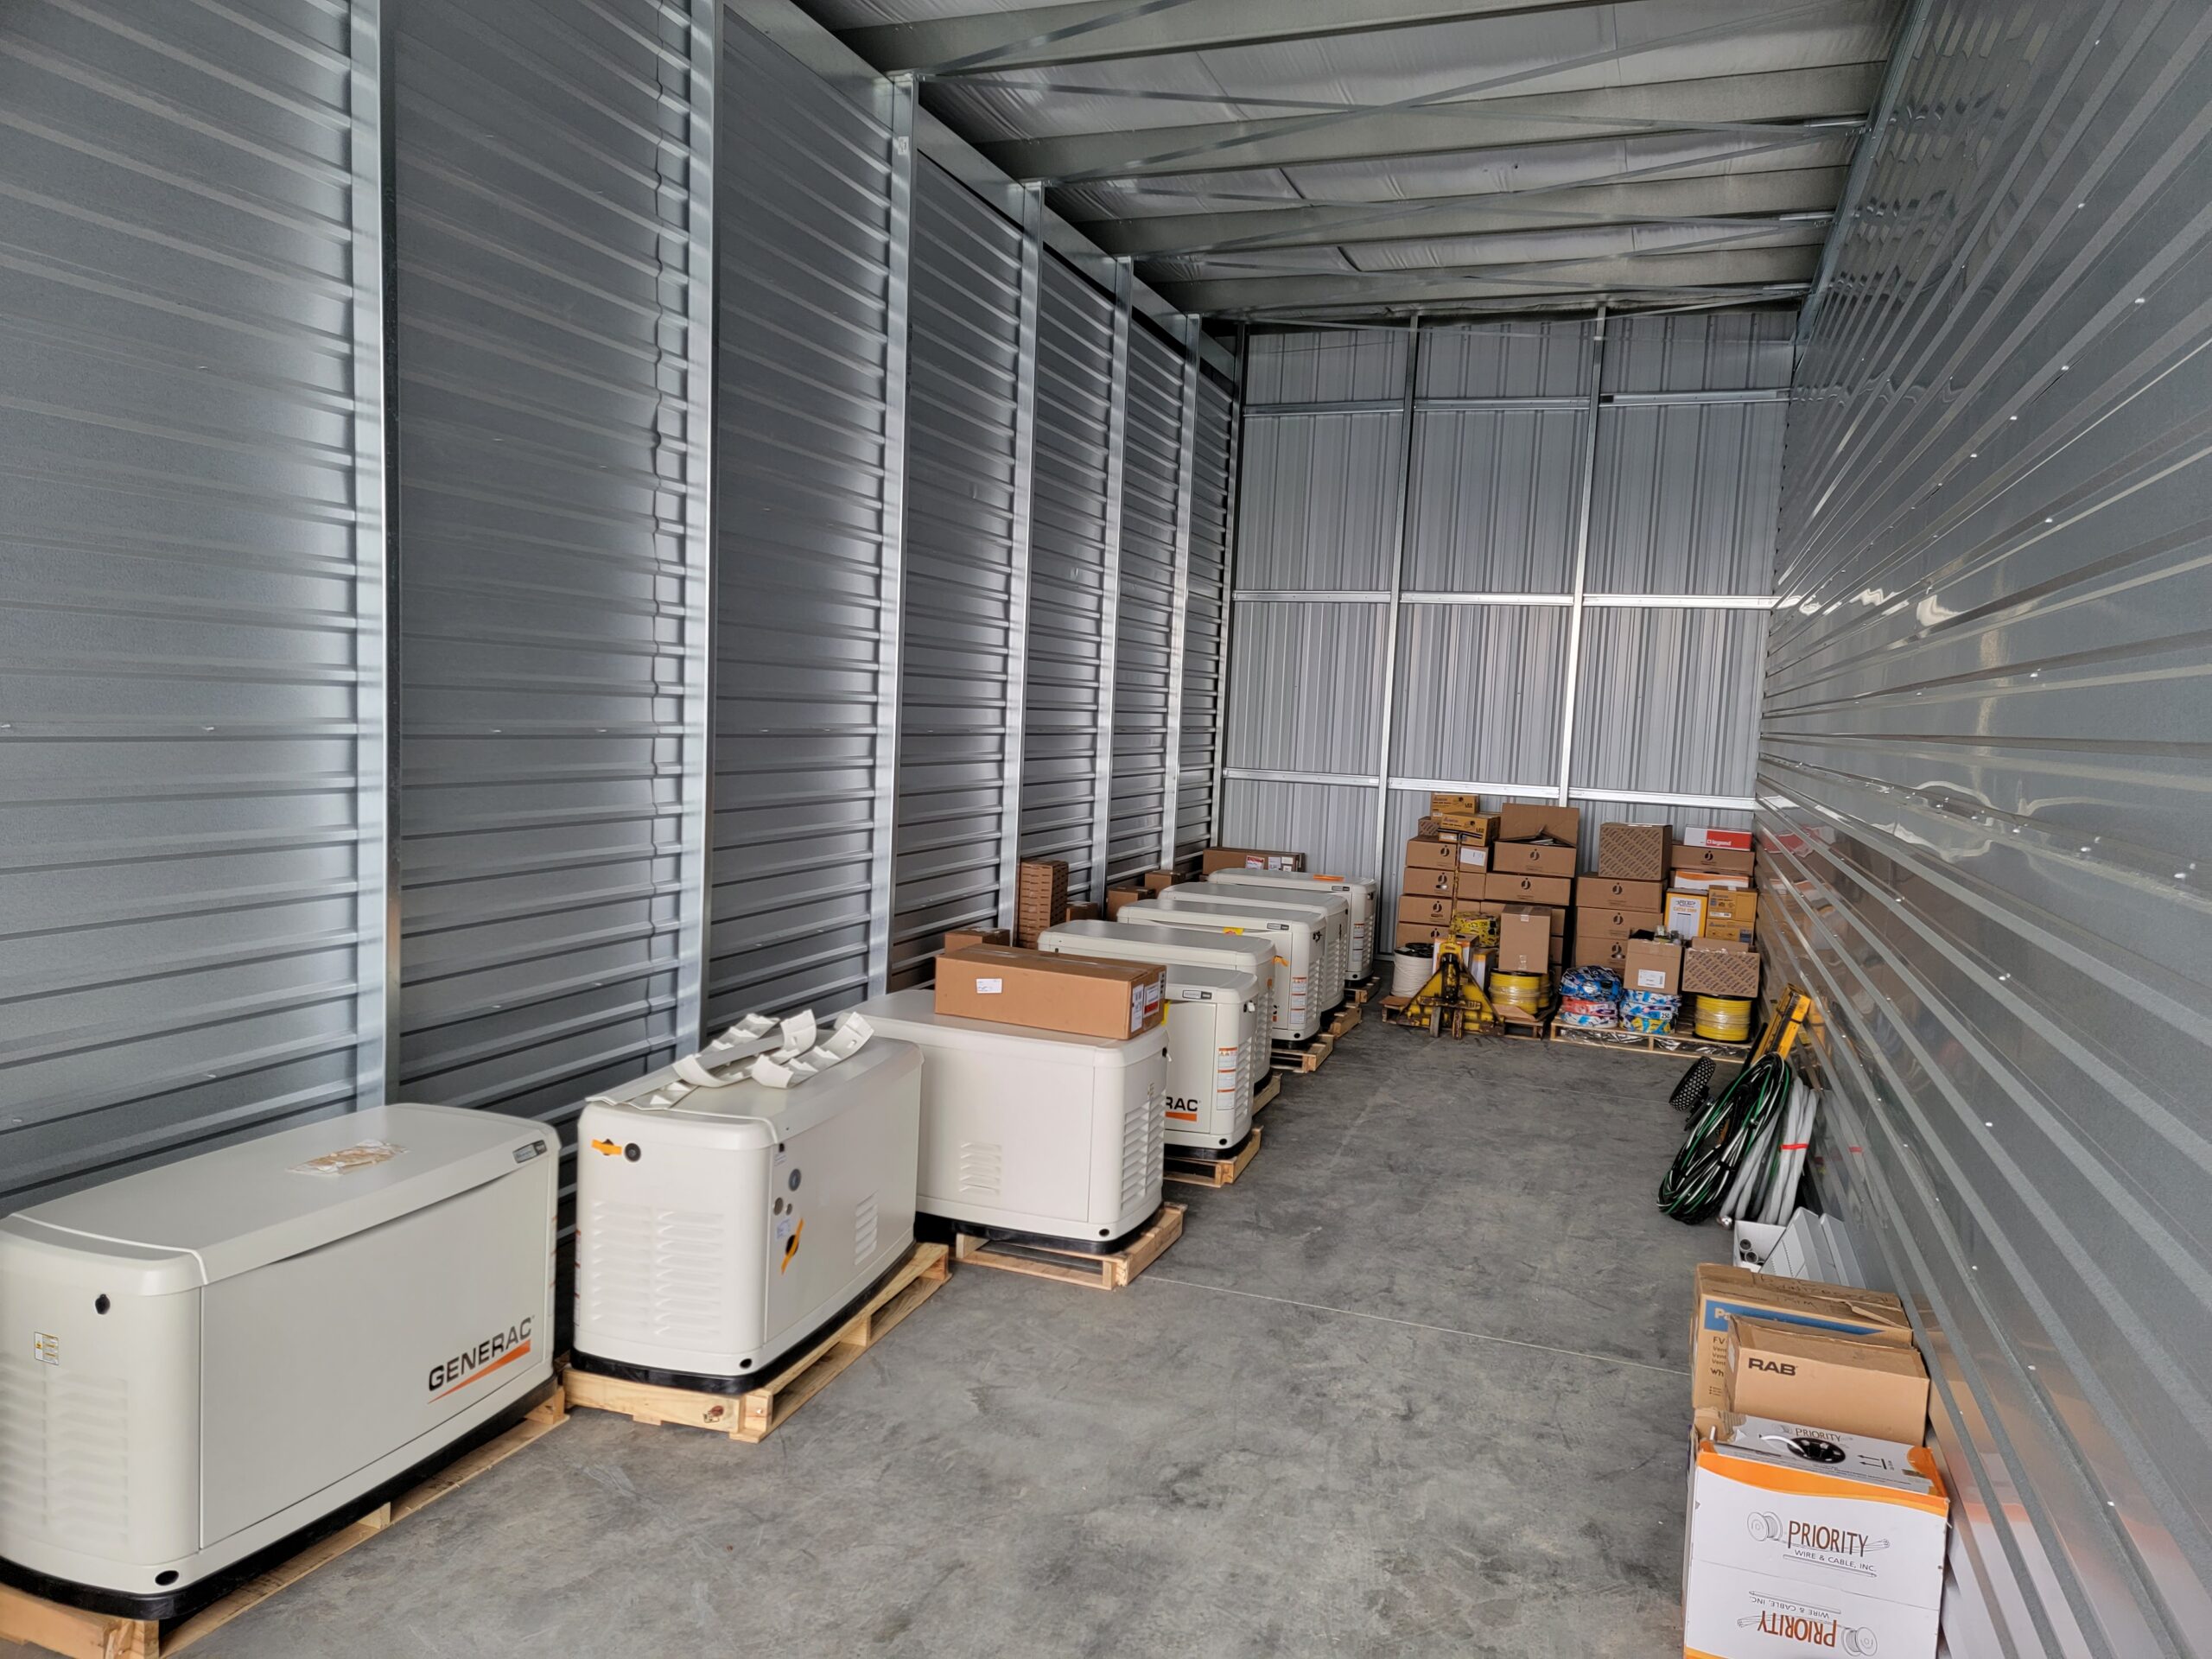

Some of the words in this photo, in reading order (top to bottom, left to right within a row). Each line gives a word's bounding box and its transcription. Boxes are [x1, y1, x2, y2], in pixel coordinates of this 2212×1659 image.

[429, 1317, 532, 1392] GENERAC
[1709, 1367, 1725, 1377] Wh
[1748, 1357, 1797, 1376] RAB
[1795, 1427, 1841, 1442] PRIORITY
[1787, 1520, 1869, 1558] PRIORITY
[1794, 1549, 1816, 1560] WIRE
[1827, 1556, 1857, 1569] CABLE,
[1859, 1563, 1878, 1573] INC.
[1749, 1596, 1765, 1605] INC.
[1768, 1599, 1796, 1611] CABLE,
[1808, 1609, 1830, 1619] WIRE
[1757, 1610, 1838, 1649] PRIORITY
